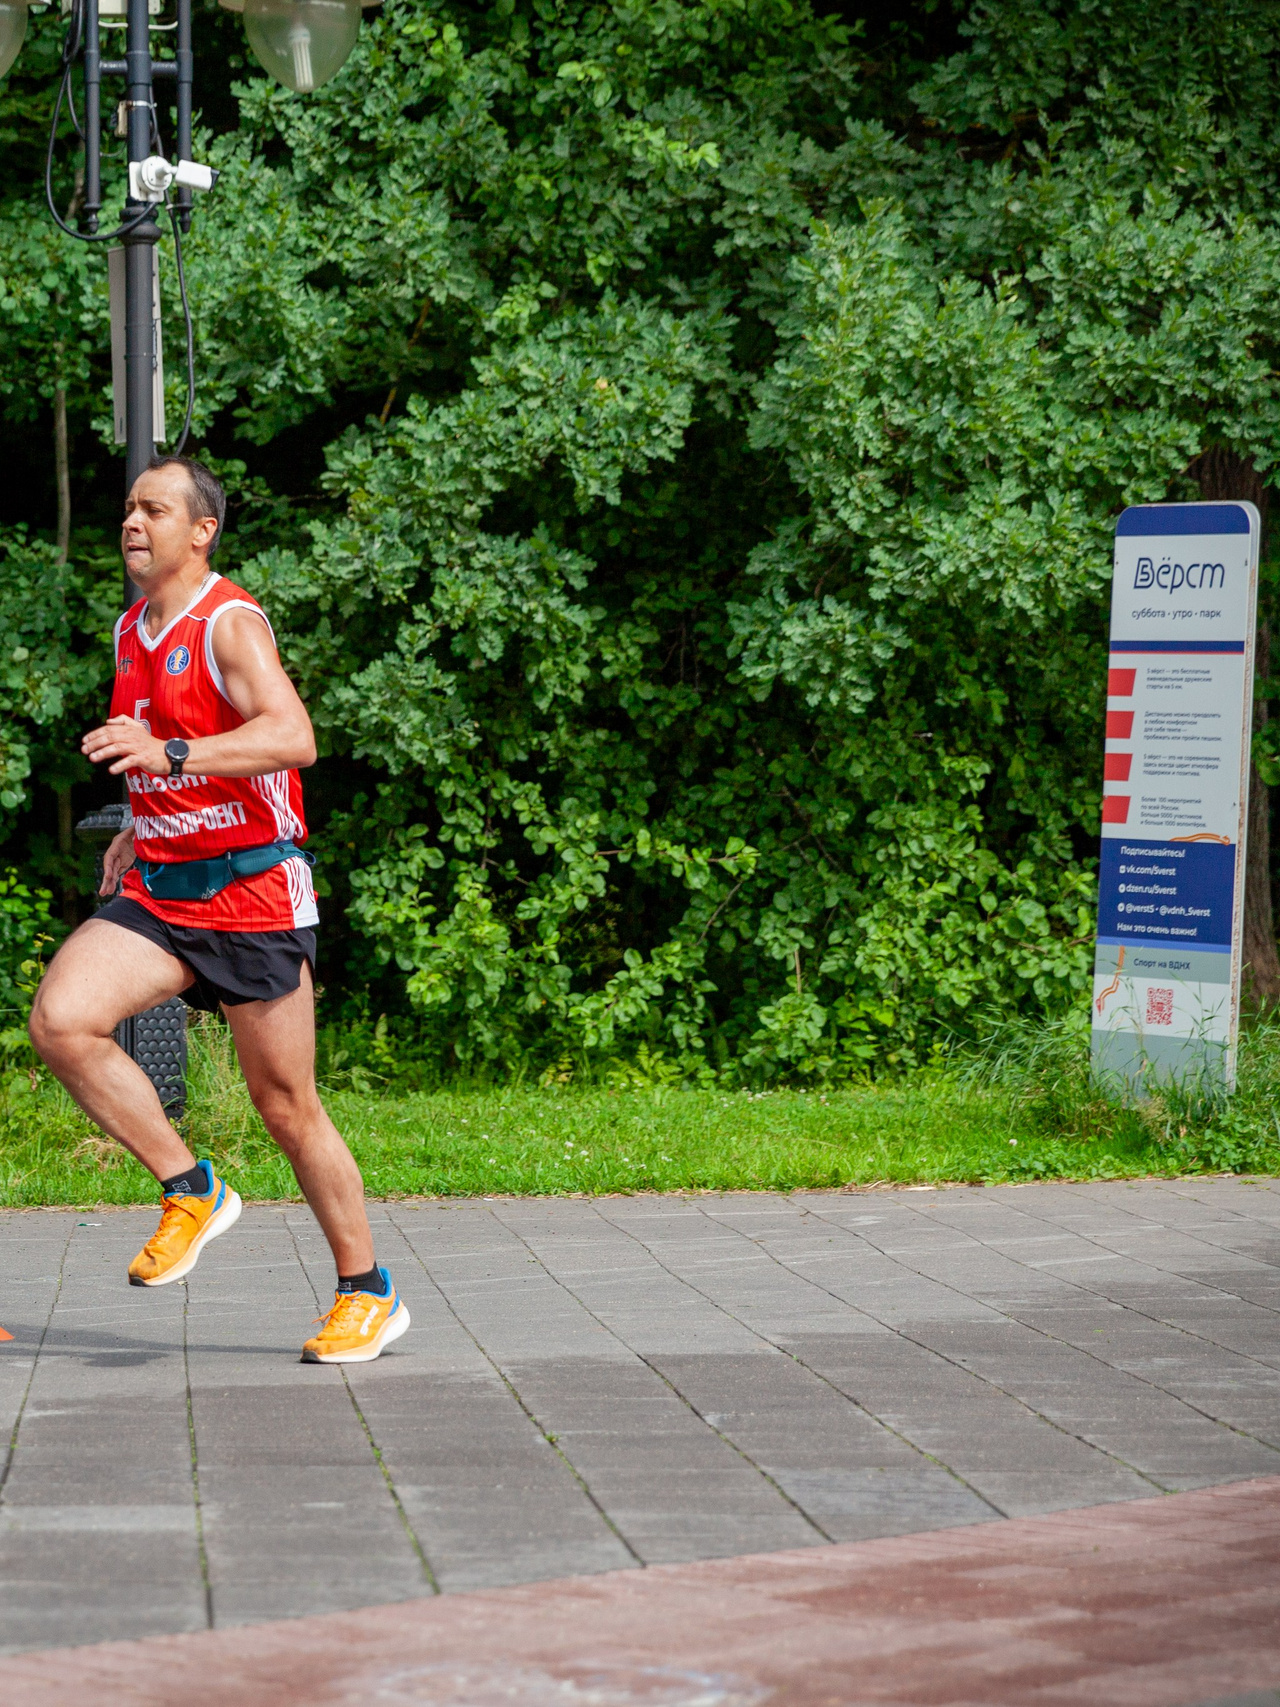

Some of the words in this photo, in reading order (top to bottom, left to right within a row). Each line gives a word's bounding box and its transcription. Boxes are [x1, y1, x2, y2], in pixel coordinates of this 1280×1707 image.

[1131, 608, 1166, 620] суббота
[1171, 610, 1193, 620] утро
[1199, 609, 1222, 620] парк
[1120, 846, 1186, 858] Подписывайтесь!
[1117, 922, 1133, 932] Нам
[1133, 925, 1146, 933] это
[1146, 925, 1170, 935] очень
[1170, 926, 1197, 936] важно!
[1133, 958, 1156, 968] Спорт
[1168, 962, 1191, 970] ВДНХ
